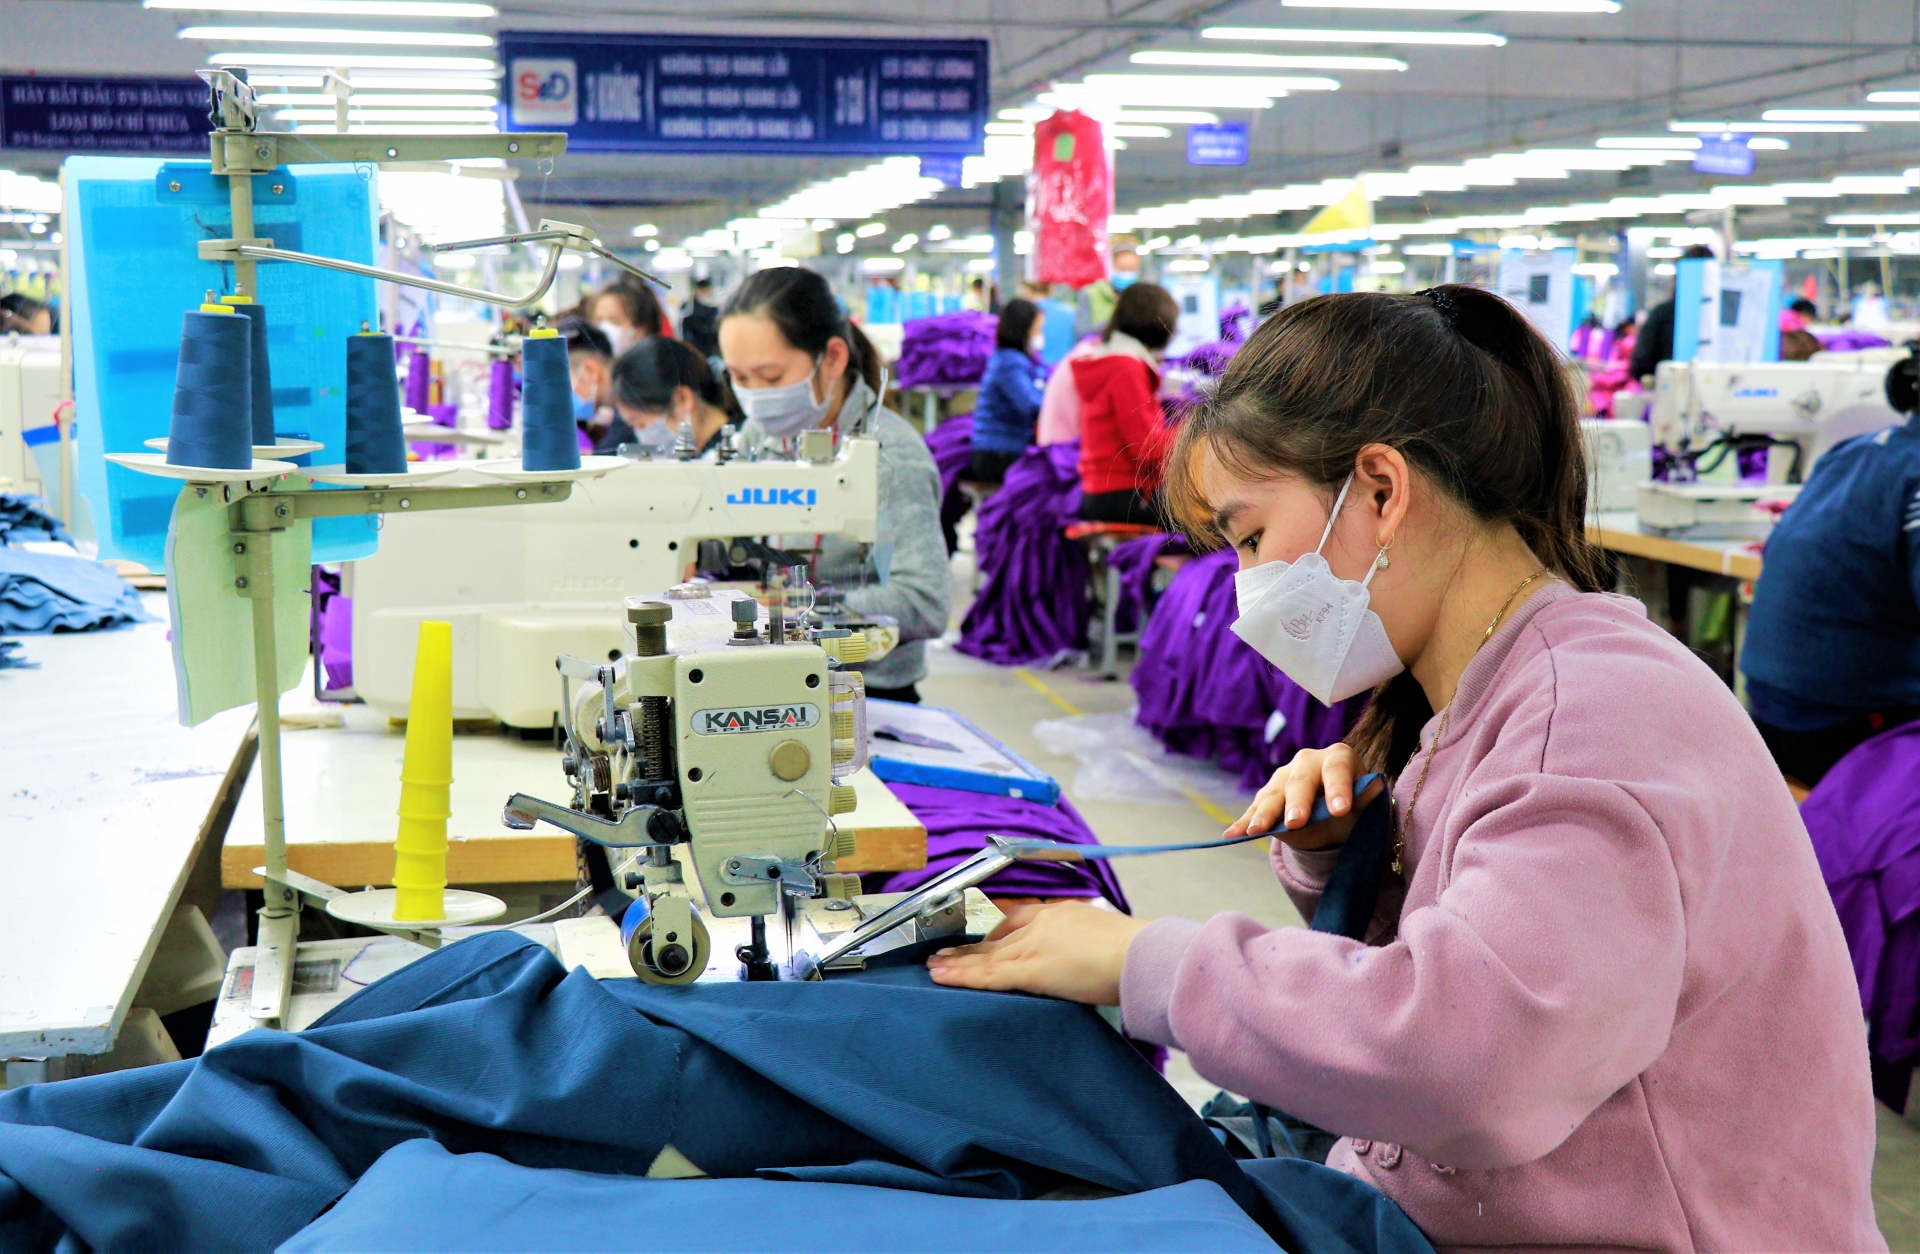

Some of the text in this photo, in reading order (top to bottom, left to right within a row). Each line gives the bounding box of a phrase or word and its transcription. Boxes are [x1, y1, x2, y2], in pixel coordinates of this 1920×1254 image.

[726, 488, 816, 505] JUKI
[1315, 602, 1333, 624] KF94
[705, 706, 806, 729] KANSAI
[706, 722, 806, 733] SPECIAL
